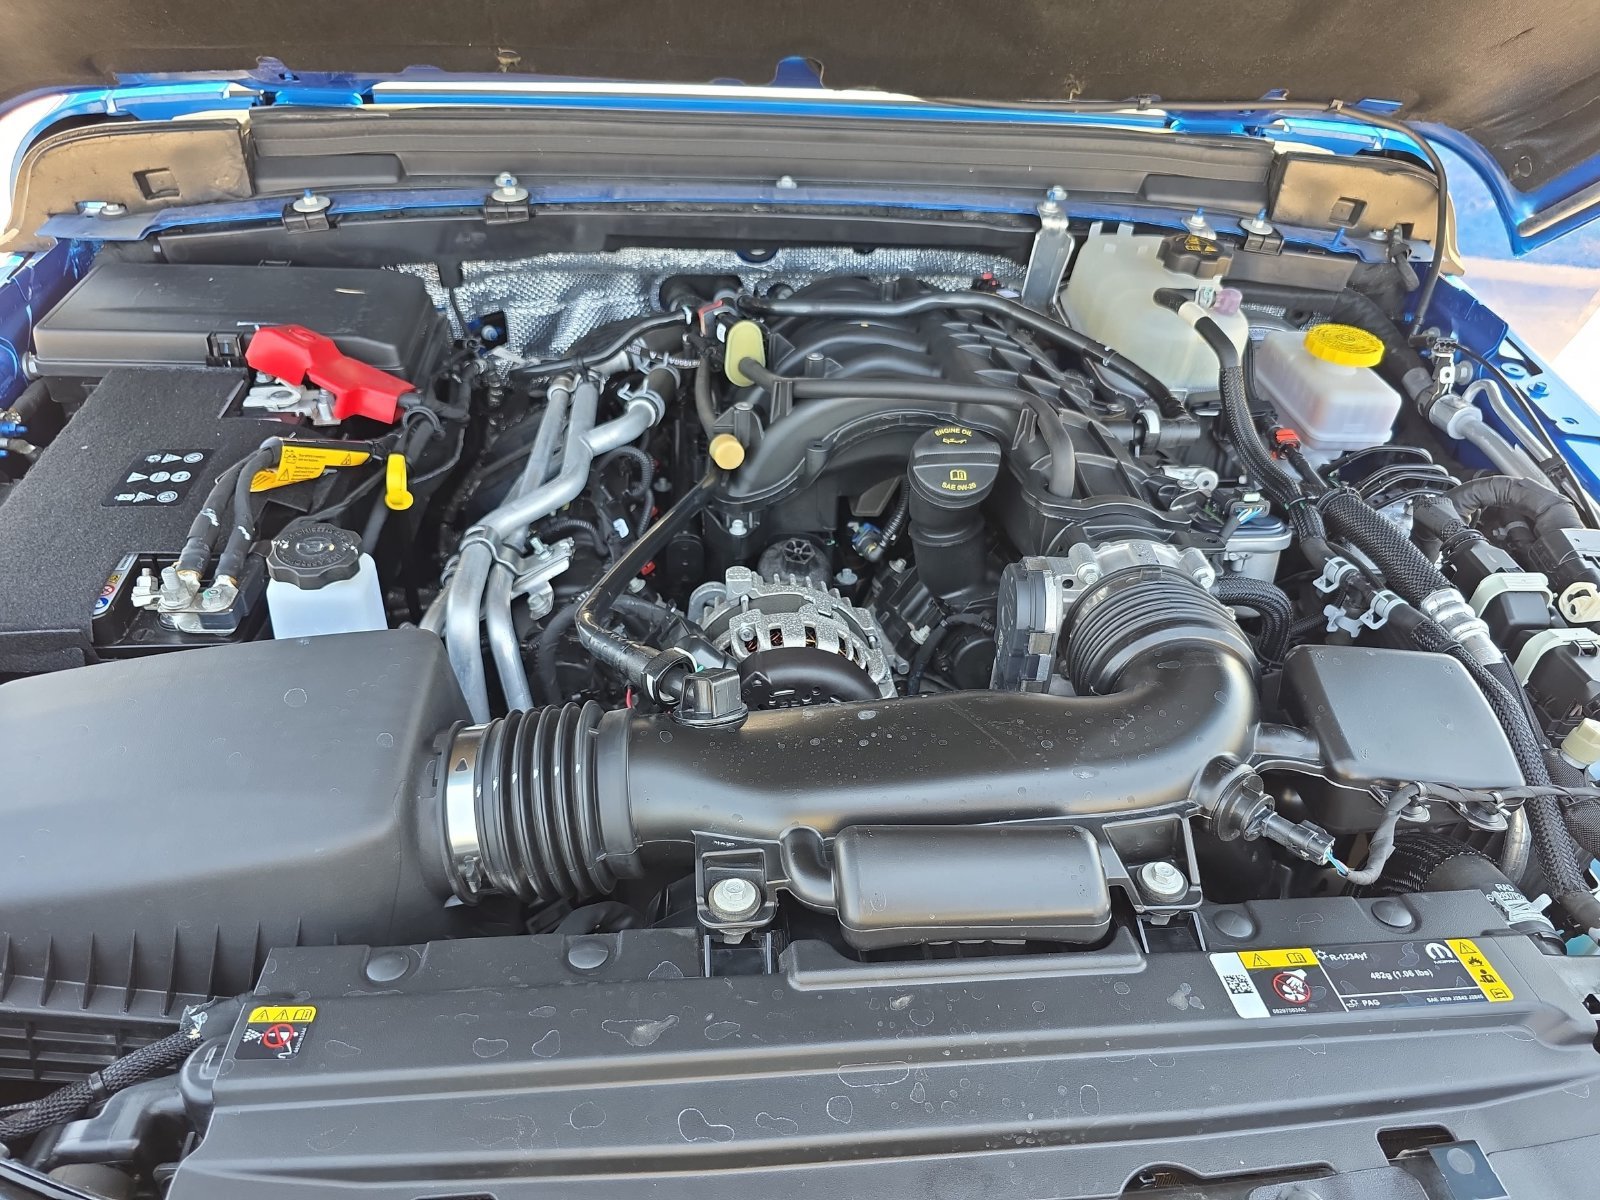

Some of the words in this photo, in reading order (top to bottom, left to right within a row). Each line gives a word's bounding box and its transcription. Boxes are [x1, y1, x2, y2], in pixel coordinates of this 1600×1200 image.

[934, 427, 960, 437] ENGINE
[961, 428, 973, 437] OIL
[941, 481, 956, 491] SAE
[956, 481, 977, 491] 0W-20
[1495, 883, 1515, 892] RAD
[1328, 951, 1369, 961] R-1234yf
[1393, 968, 1415, 980] (1.06
[1415, 968, 1434, 979] lbs)
[1361, 999, 1381, 1007] PAG
